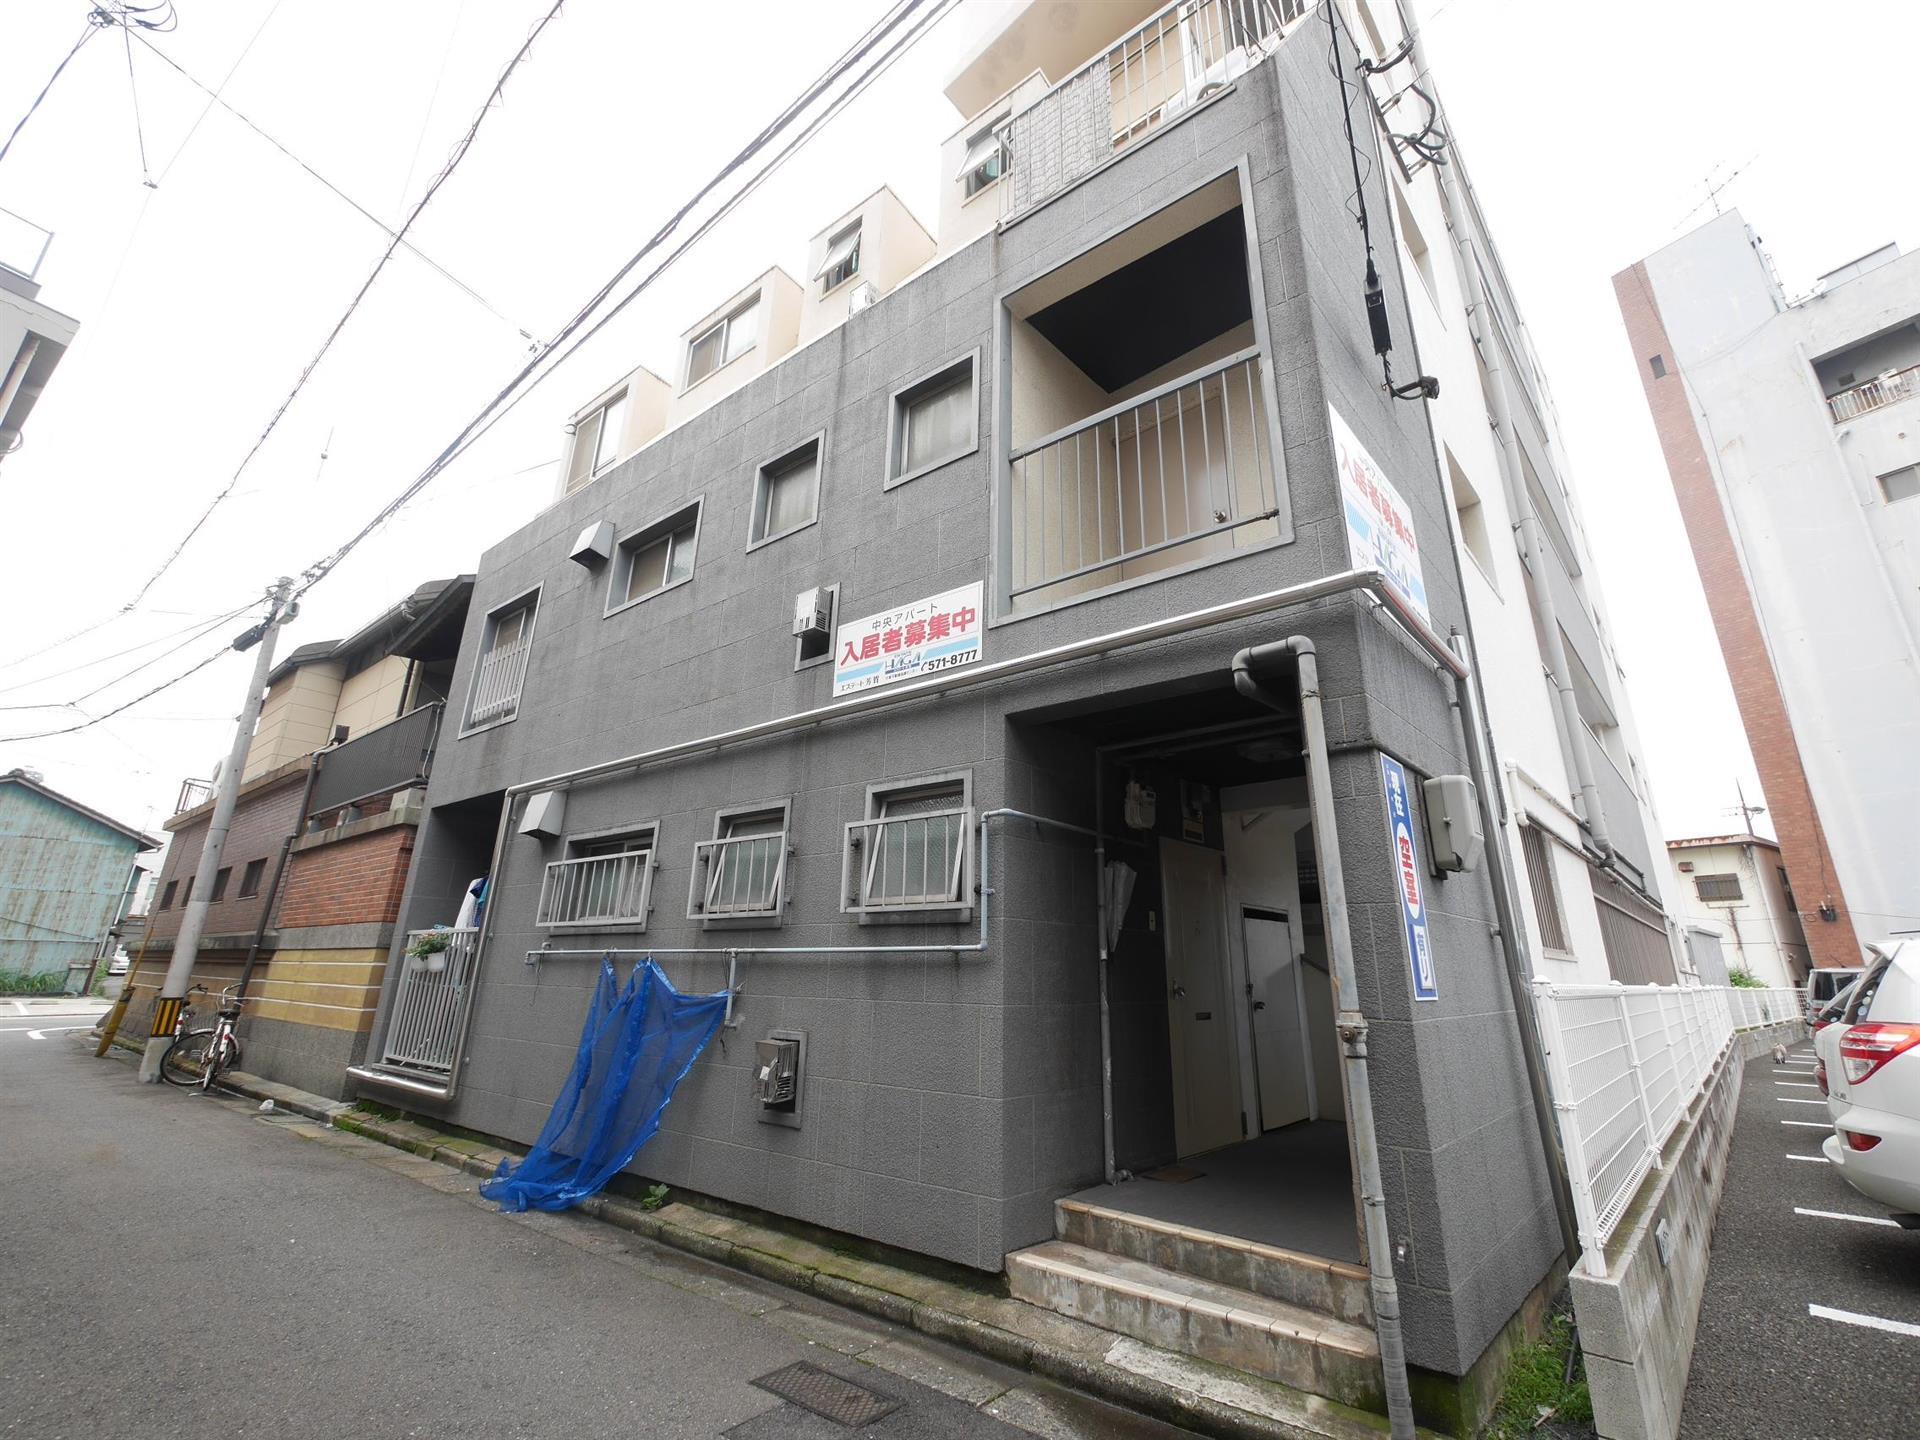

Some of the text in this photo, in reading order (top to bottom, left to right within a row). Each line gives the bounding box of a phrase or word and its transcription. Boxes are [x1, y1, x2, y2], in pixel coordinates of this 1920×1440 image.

[840, 606, 976, 666] 入居者募集中
[872, 603, 938, 631] 中央アパート
[927, 649, 977, 671] 571-8777
[1398, 835, 1419, 907] 空室
